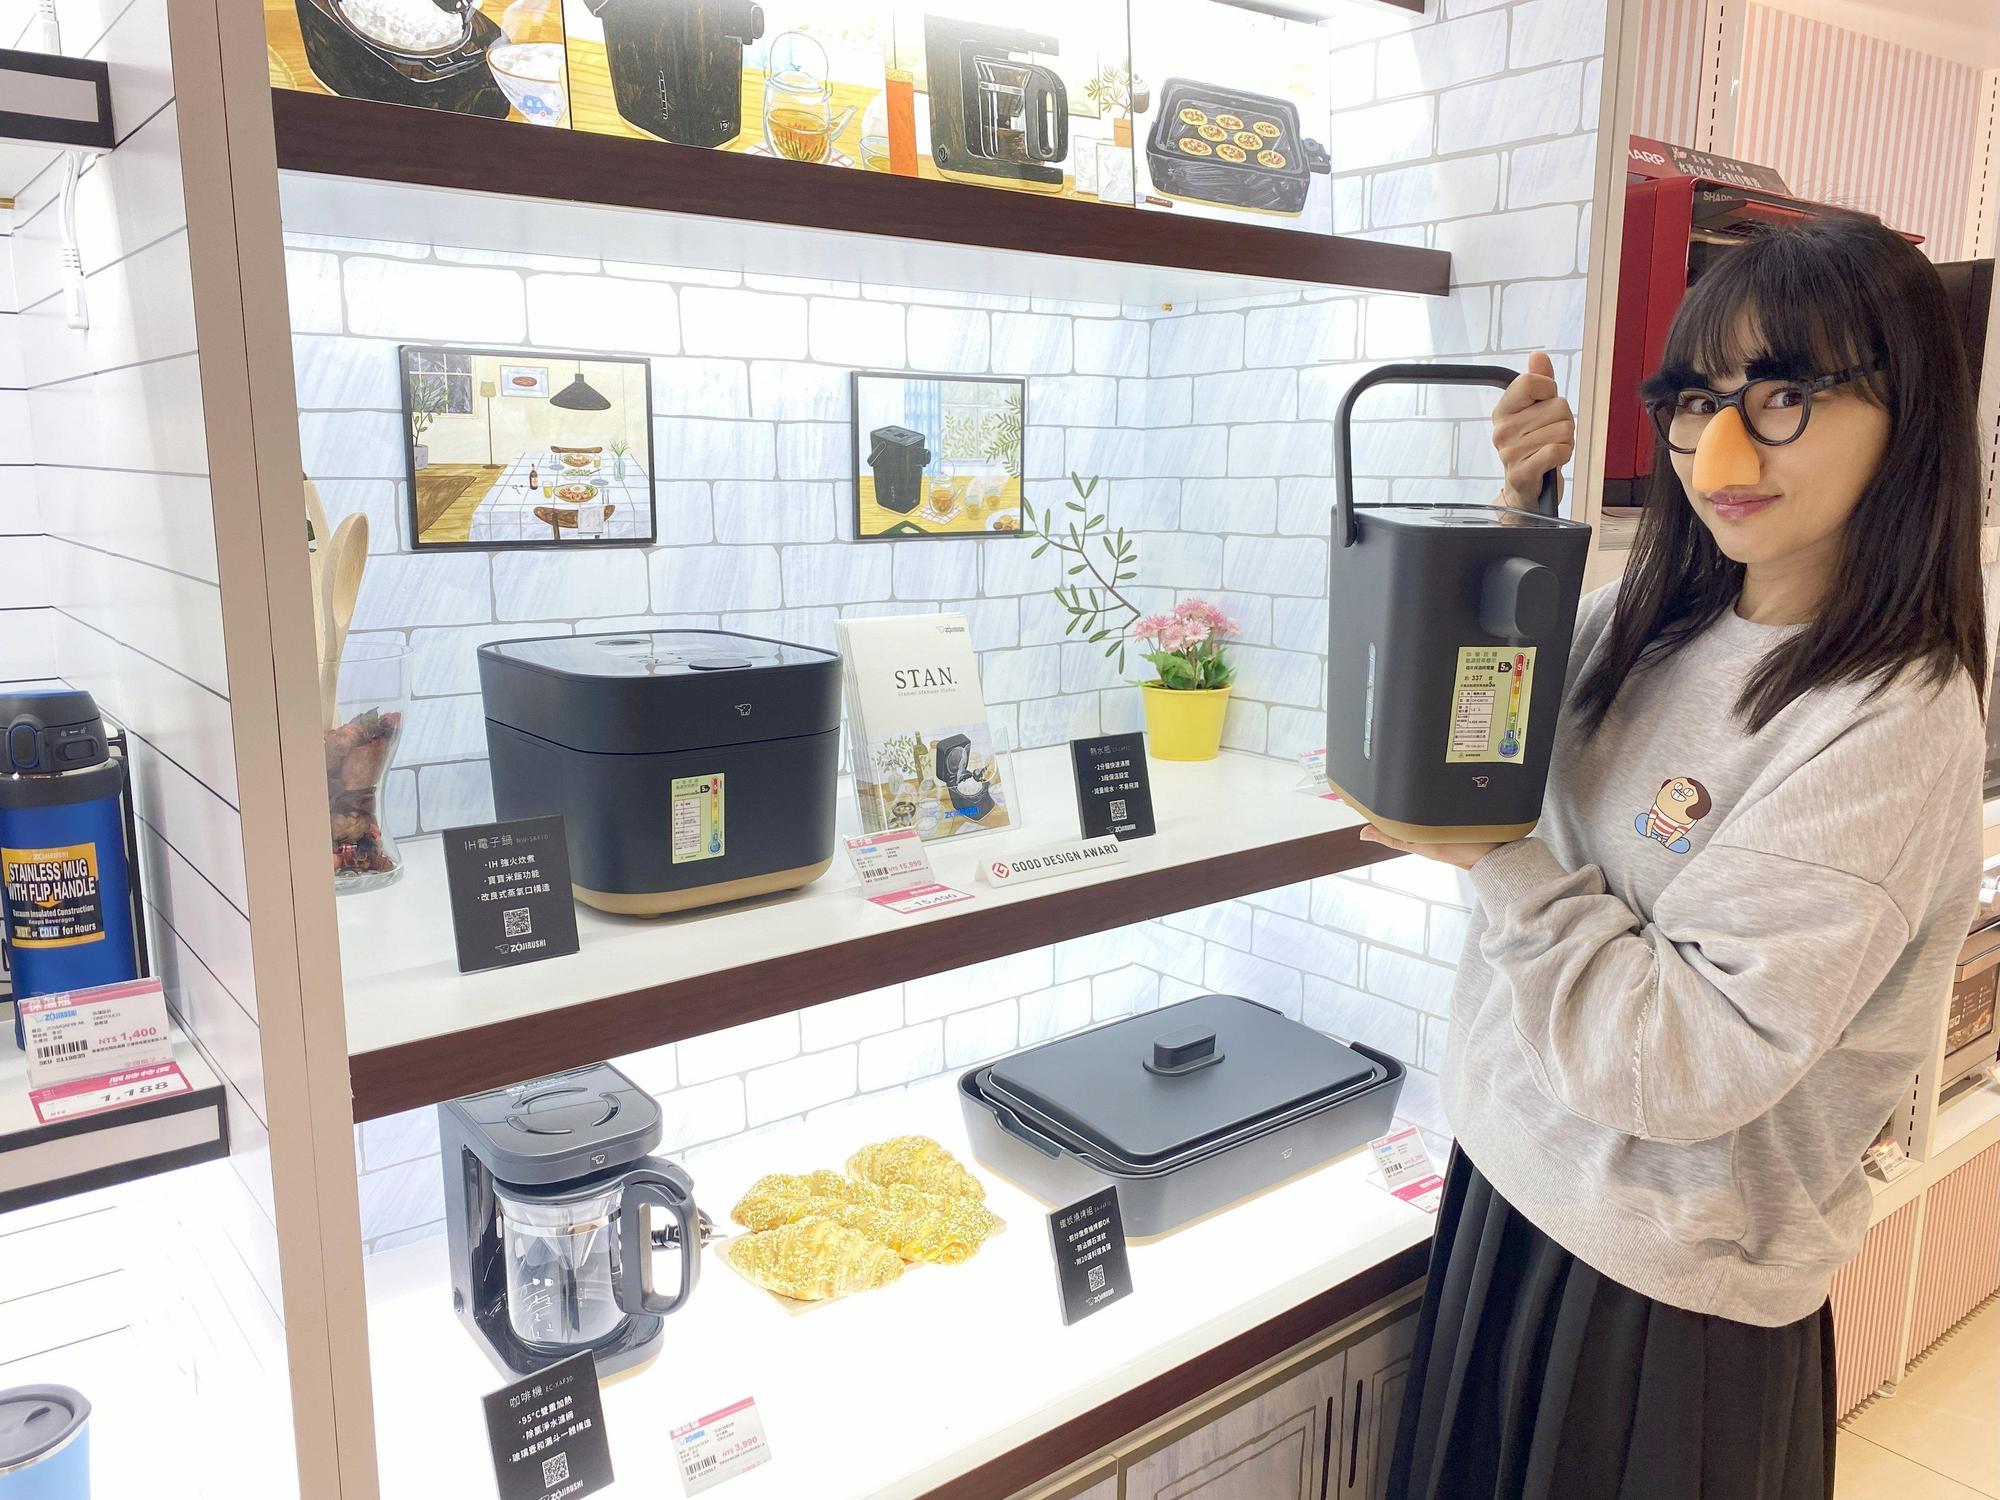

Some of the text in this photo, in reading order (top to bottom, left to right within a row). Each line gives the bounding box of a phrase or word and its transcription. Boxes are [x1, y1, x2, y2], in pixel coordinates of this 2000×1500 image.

[894, 667, 957, 689] STAN.
[464, 834, 513, 851] IH電子鍋
[1011, 843, 1119, 873] GOOD DESIGN AWARD
[10, 859, 87, 881] STAINLESS MUG
[8, 877, 96, 901] WITH FLIP HANDLE
[13, 904, 94, 918] Vacuum Insulated Construction
[39, 926, 59, 937] COLD
[62, 926, 73, 935] for
[75, 922, 96, 933] Hours
[510, 939, 546, 953] ZOJIRUSHI
[99, 1036, 118, 1045] NT$
[120, 1026, 157, 1041] 1,400
[509, 1385, 543, 1408] 咖啡機
[734, 1435, 758, 1451] 3,990
